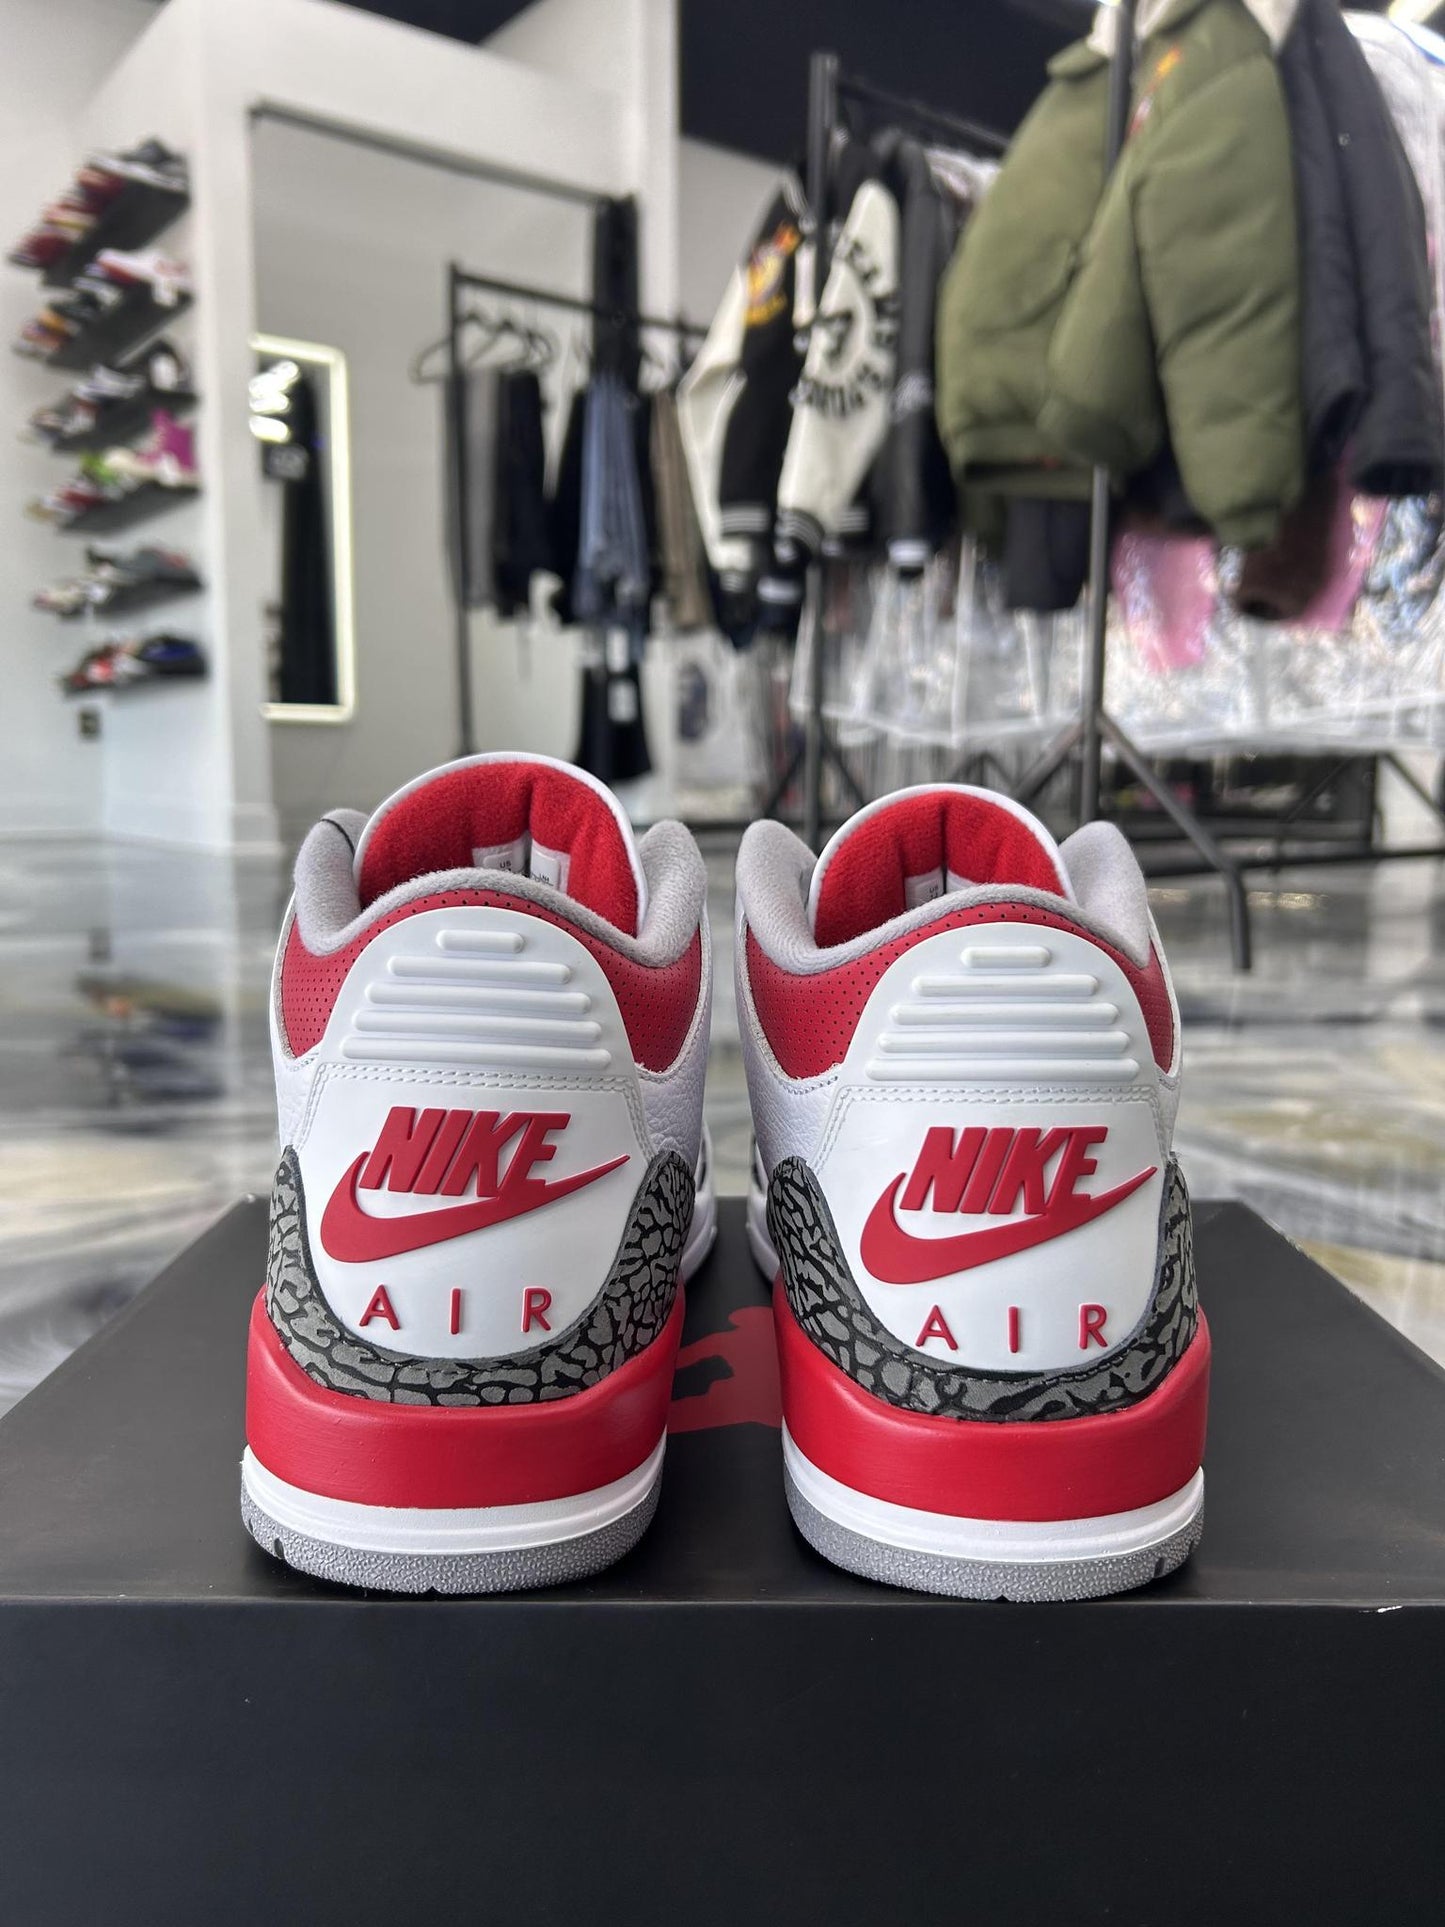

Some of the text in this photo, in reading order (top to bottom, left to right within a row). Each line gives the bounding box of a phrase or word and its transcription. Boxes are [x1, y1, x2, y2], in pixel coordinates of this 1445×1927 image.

[359, 1106, 571, 1197] NIKE
[899, 1126, 1108, 1214] NIKE
[359, 1284, 553, 1335] AIR
[915, 1304, 1108, 1354] AIR
